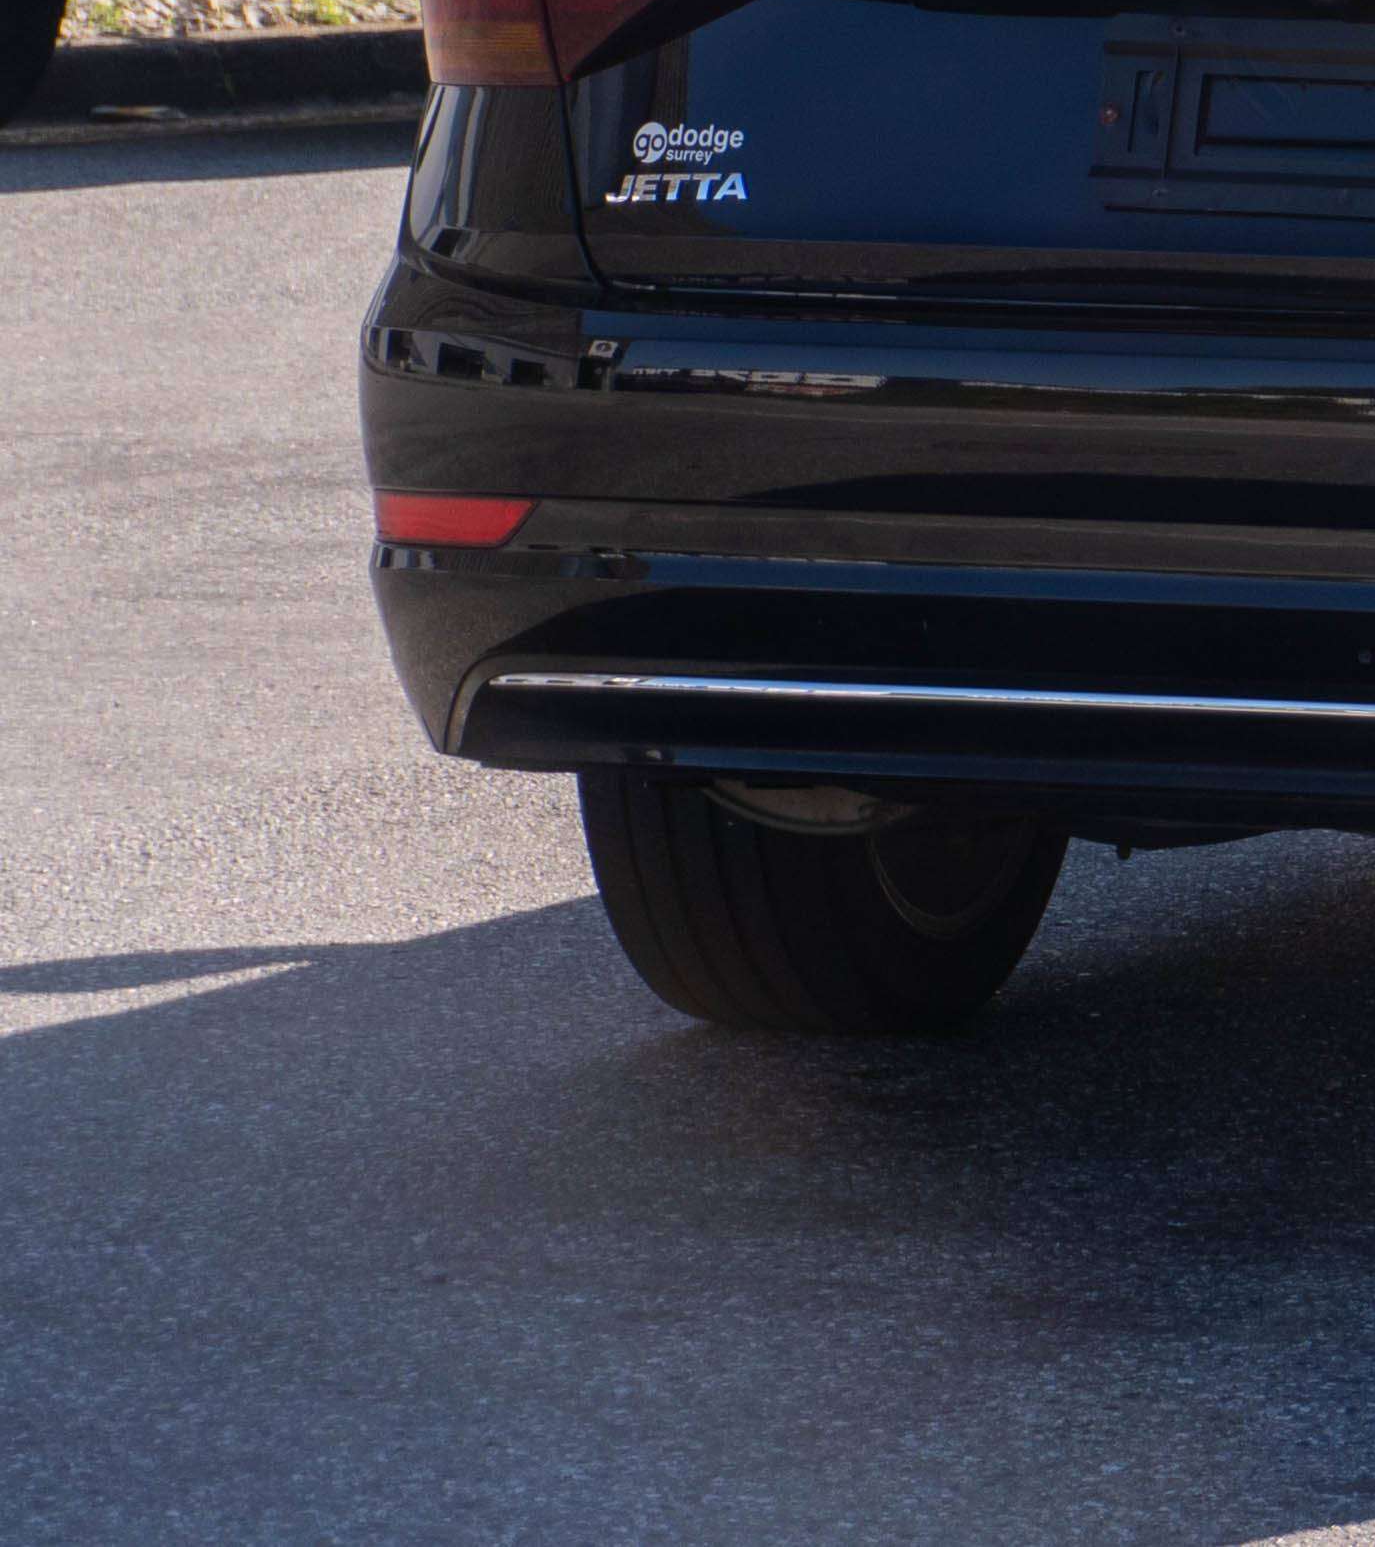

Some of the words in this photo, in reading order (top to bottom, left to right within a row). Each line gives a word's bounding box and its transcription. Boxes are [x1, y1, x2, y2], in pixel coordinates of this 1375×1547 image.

[634, 131, 667, 163] go
[668, 124, 745, 153] dodge
[665, 149, 713, 165] surrey
[605, 172, 748, 203] JETTA
